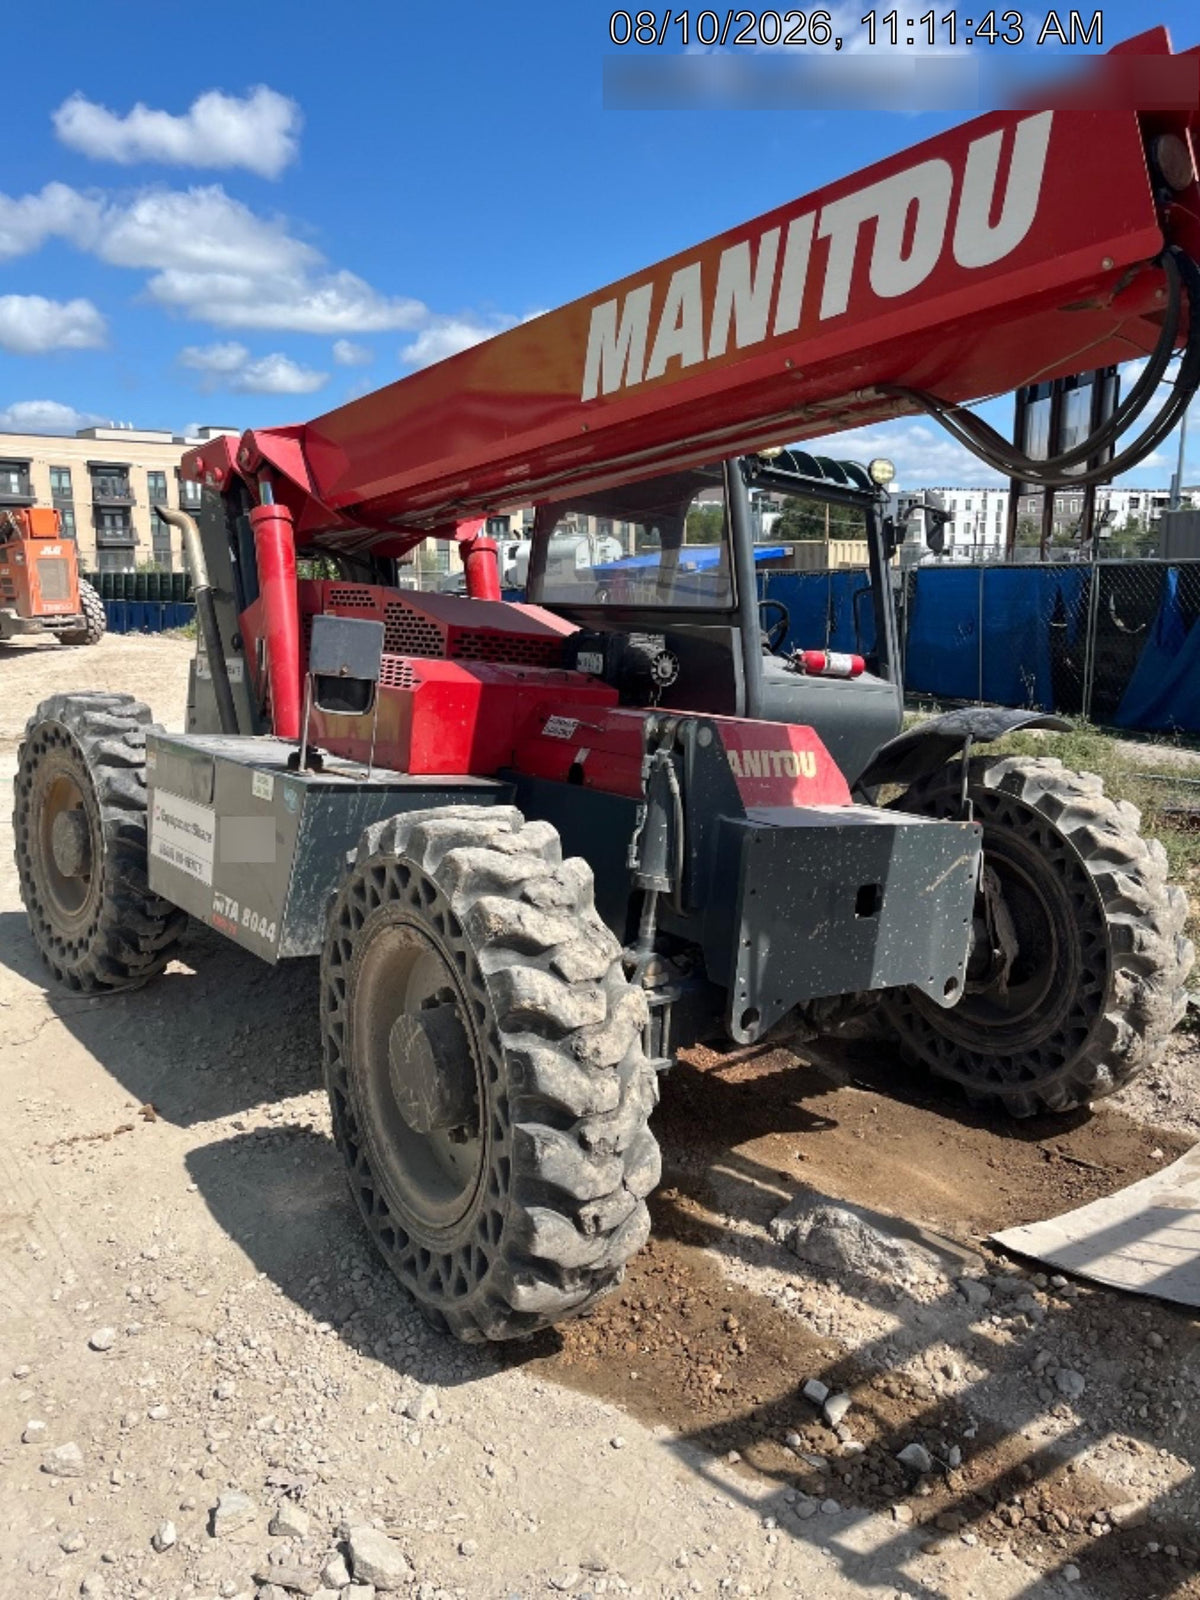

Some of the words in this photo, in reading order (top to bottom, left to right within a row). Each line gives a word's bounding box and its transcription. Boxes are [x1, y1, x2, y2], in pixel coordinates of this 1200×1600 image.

[581, 109, 1055, 403] MANITOU
[727, 750, 816, 777] ANITOU
[242, 908, 276, 943] 8044
